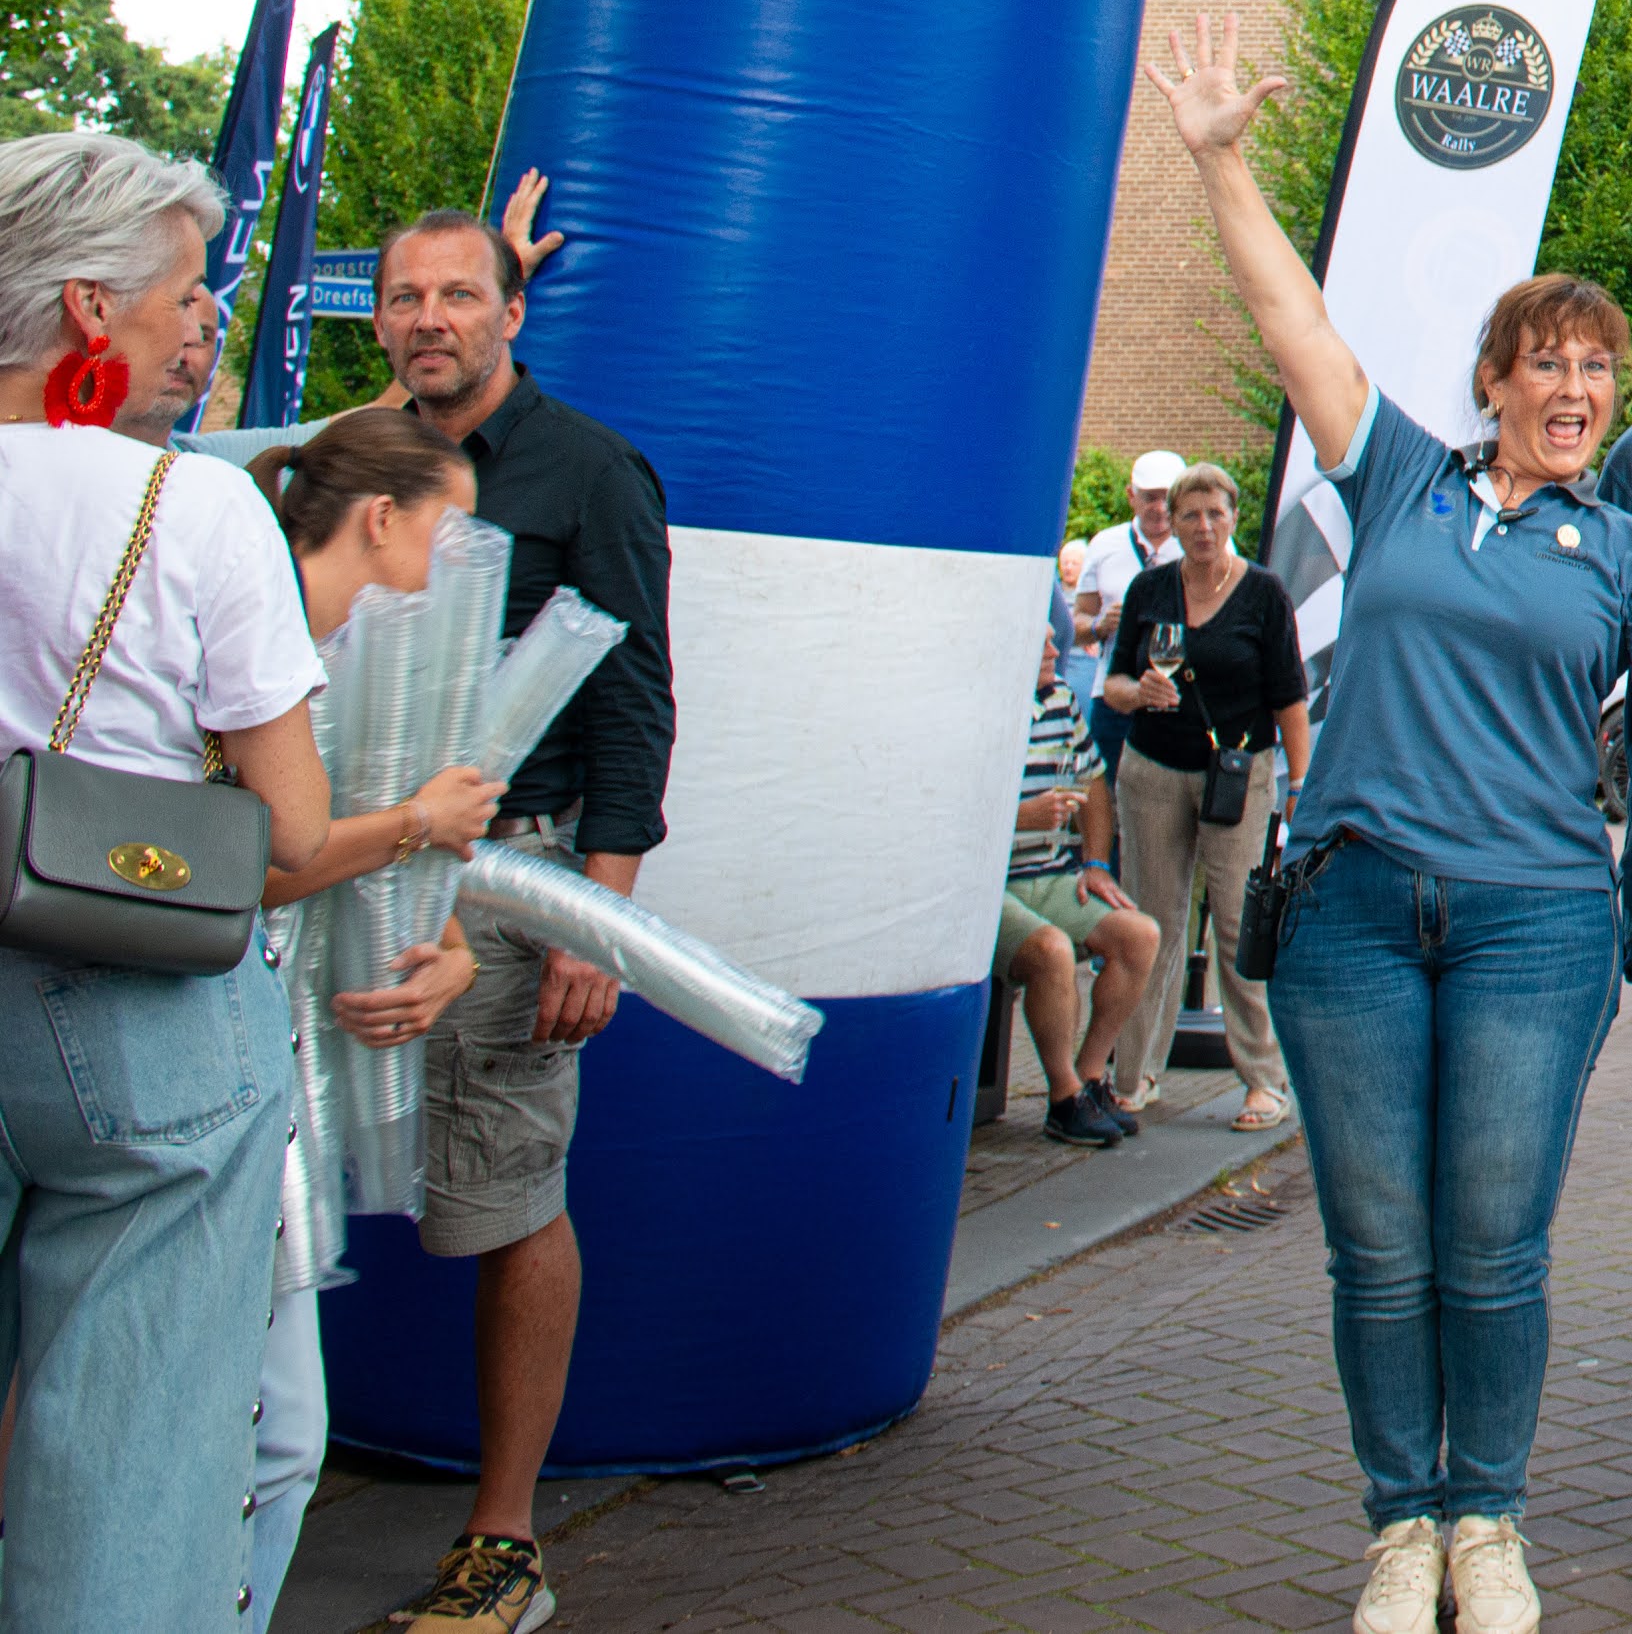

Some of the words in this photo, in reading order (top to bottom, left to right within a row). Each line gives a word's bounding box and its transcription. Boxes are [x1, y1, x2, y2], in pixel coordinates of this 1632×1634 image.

[1466, 54, 1492, 72] WR
[1411, 72, 1531, 116] WAALRE
[1441, 133, 1477, 155] Rally
